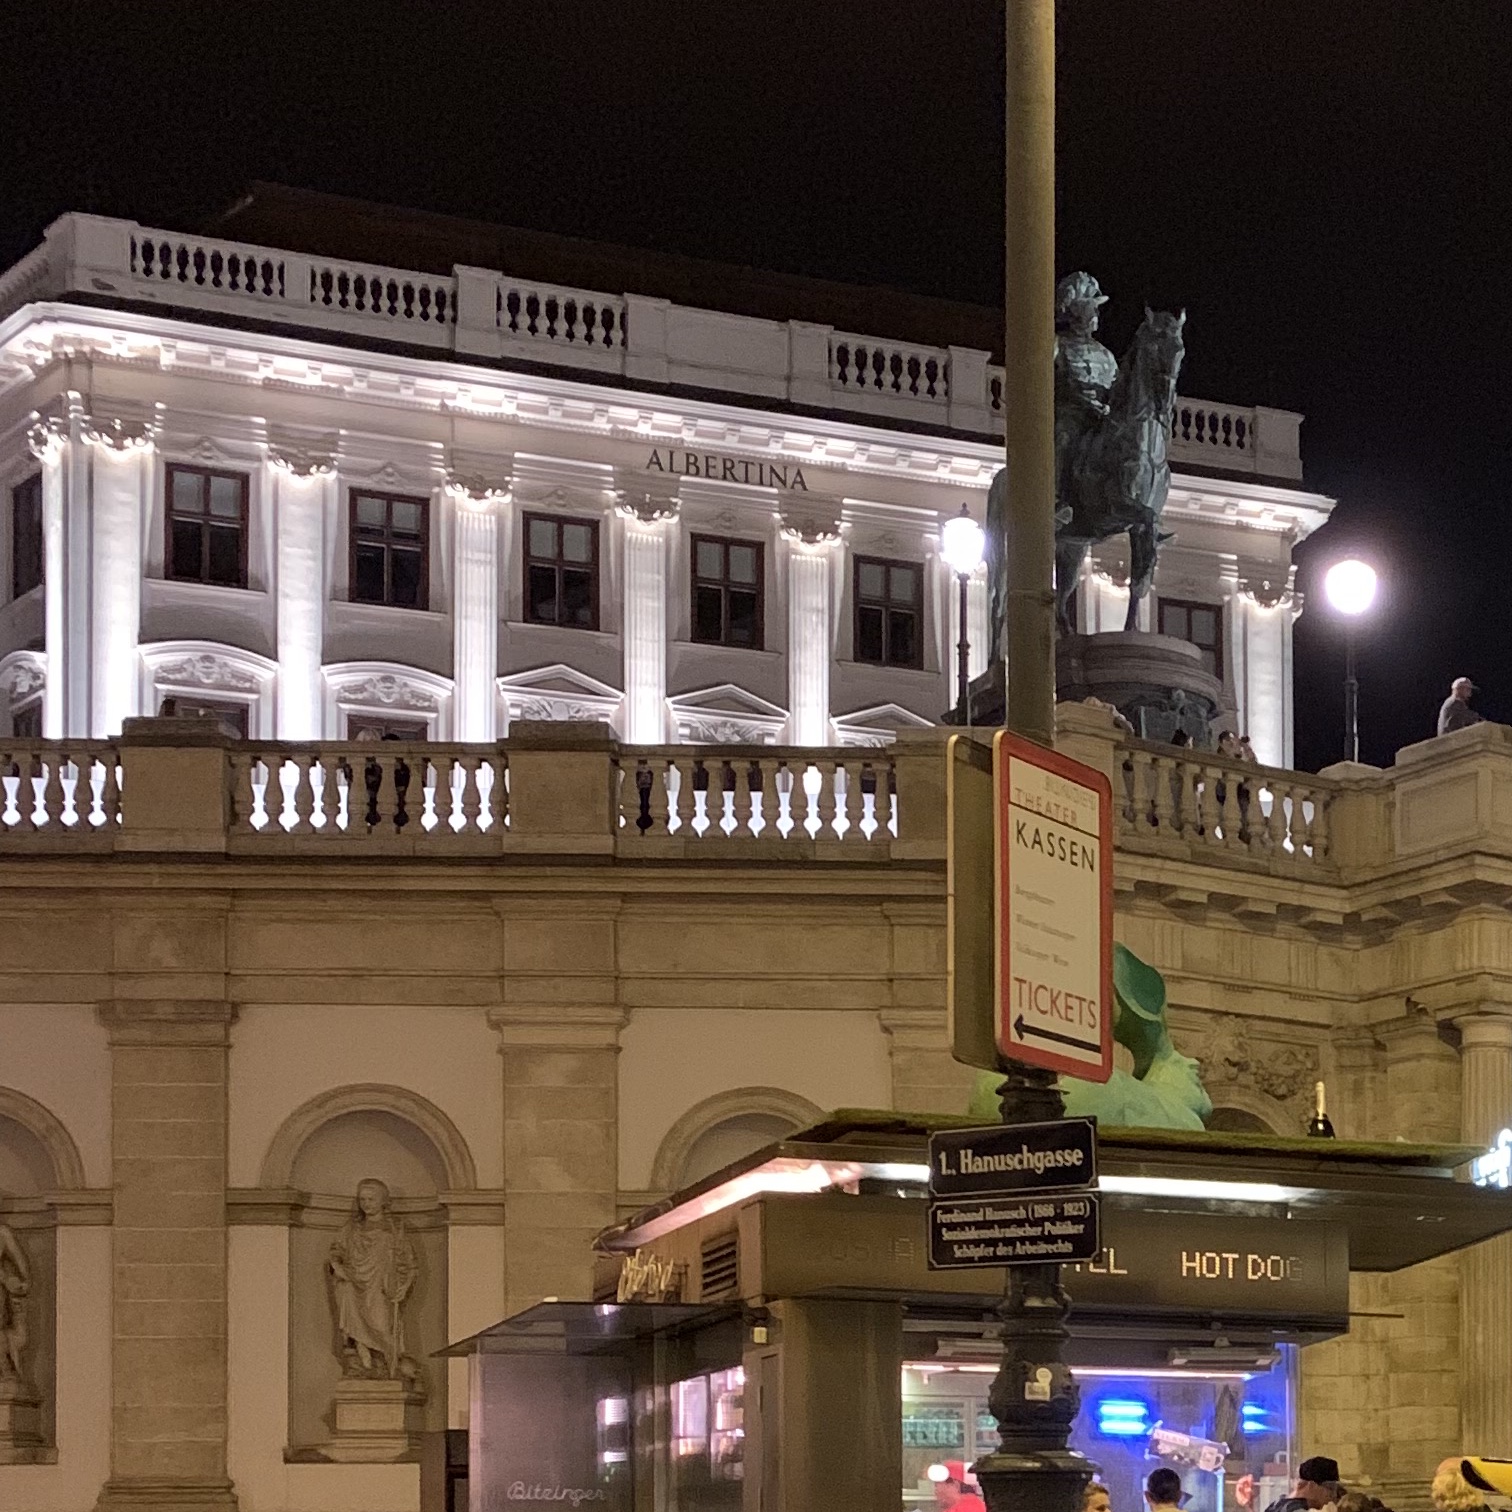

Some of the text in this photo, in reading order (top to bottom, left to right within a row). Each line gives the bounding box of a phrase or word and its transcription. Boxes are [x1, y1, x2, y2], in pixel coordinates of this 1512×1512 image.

[645, 448, 809, 492] ALBERTINA
[1014, 787, 1078, 826] THEATER
[1015, 818, 1096, 873] KASSEN
[1013, 976, 1098, 1029] TICKETS
[959, 1144, 1084, 1175] Hanuschgasse
[936, 1207, 984, 1224] Ferdinand
[984, 1205, 1027, 1222] Hanusch
[1181, 1251, 1240, 1279] HOT
